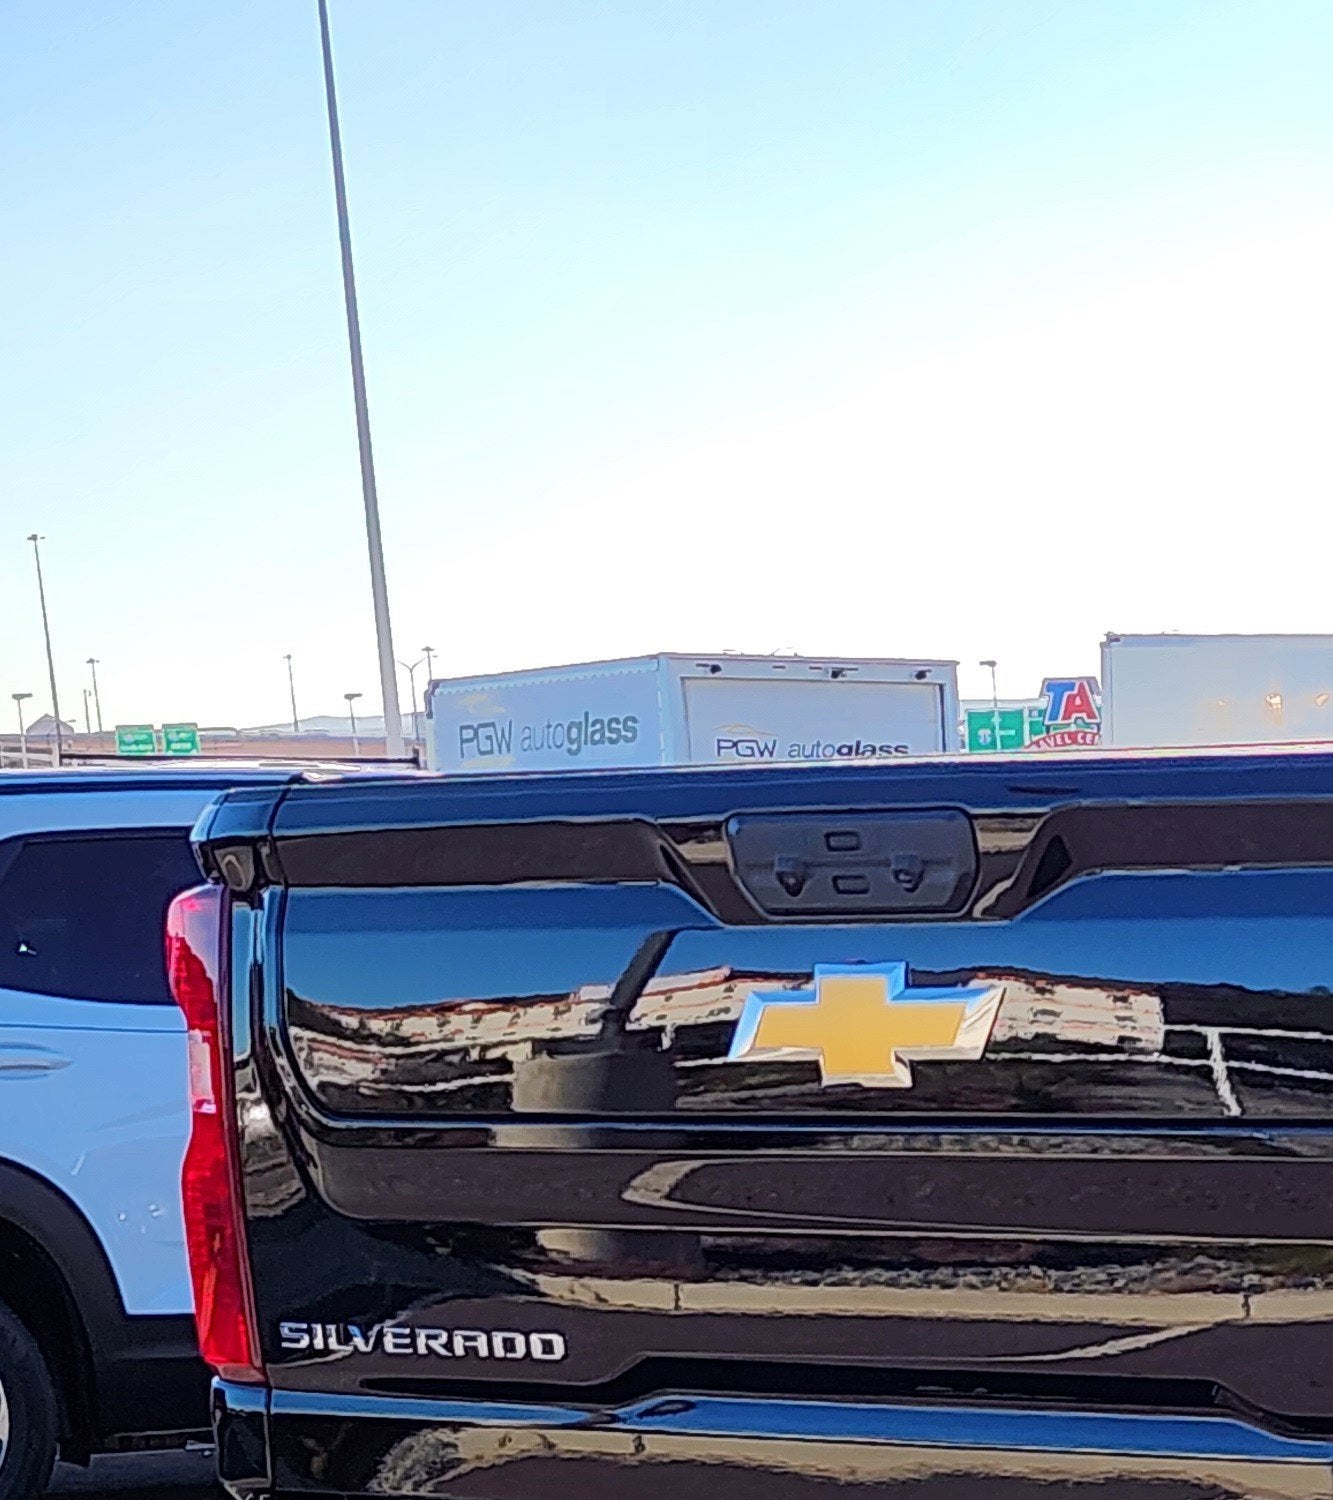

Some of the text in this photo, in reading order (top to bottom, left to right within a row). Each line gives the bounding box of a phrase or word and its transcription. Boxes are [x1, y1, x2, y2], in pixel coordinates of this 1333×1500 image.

[1045, 681, 1098, 722] TA
[459, 711, 638, 758] PGW autoglass
[716, 738, 777, 758] PGW
[279, 1321, 566, 1361] SILVERADO
